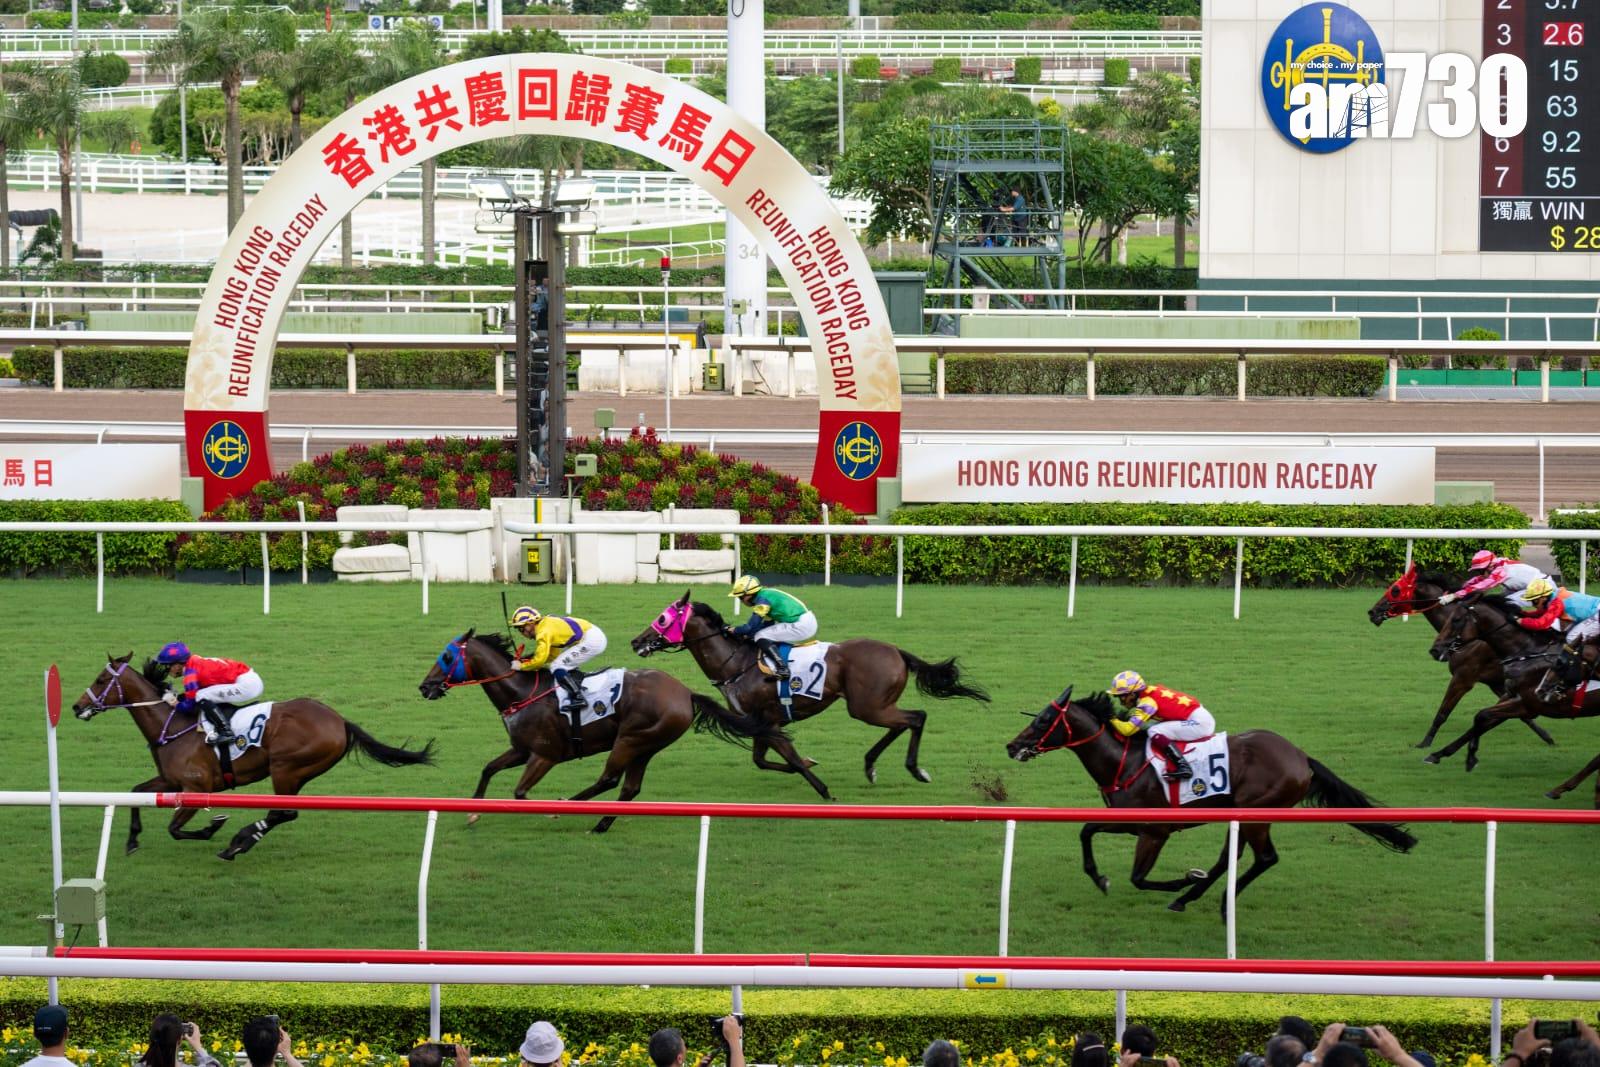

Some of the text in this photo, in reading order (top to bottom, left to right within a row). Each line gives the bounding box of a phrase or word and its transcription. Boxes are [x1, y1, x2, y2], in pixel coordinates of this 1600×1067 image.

[1497, 23, 1583, 46] 3 2.6
[1549, 59, 1579, 82] 15
[1546, 95, 1578, 117] 63
[322, 69, 756, 189] 香港共慶回歸賽馬日
[1542, 130, 1581, 153] 9.2
[1494, 166, 1577, 189] 7 55
[1493, 201, 1585, 221] 獨贏 WIN
[739, 243, 760, 260] 34
[1550, 224, 1566, 251] $
[214, 225, 274, 329] HONG KONG
[808, 225, 871, 331] HONG KONG
[228, 193, 329, 397] REUNIFICATION RACEDAY
[745, 188, 858, 400] REUNIFICATION RACEDAY
[3, 459, 53, 487] 馬日
[957, 459, 1378, 490] HONG KONG REUNIFICATION RACEDAY
[804, 661, 825, 698] 2
[248, 713, 267, 744] 6
[1208, 753, 1228, 792] 5
